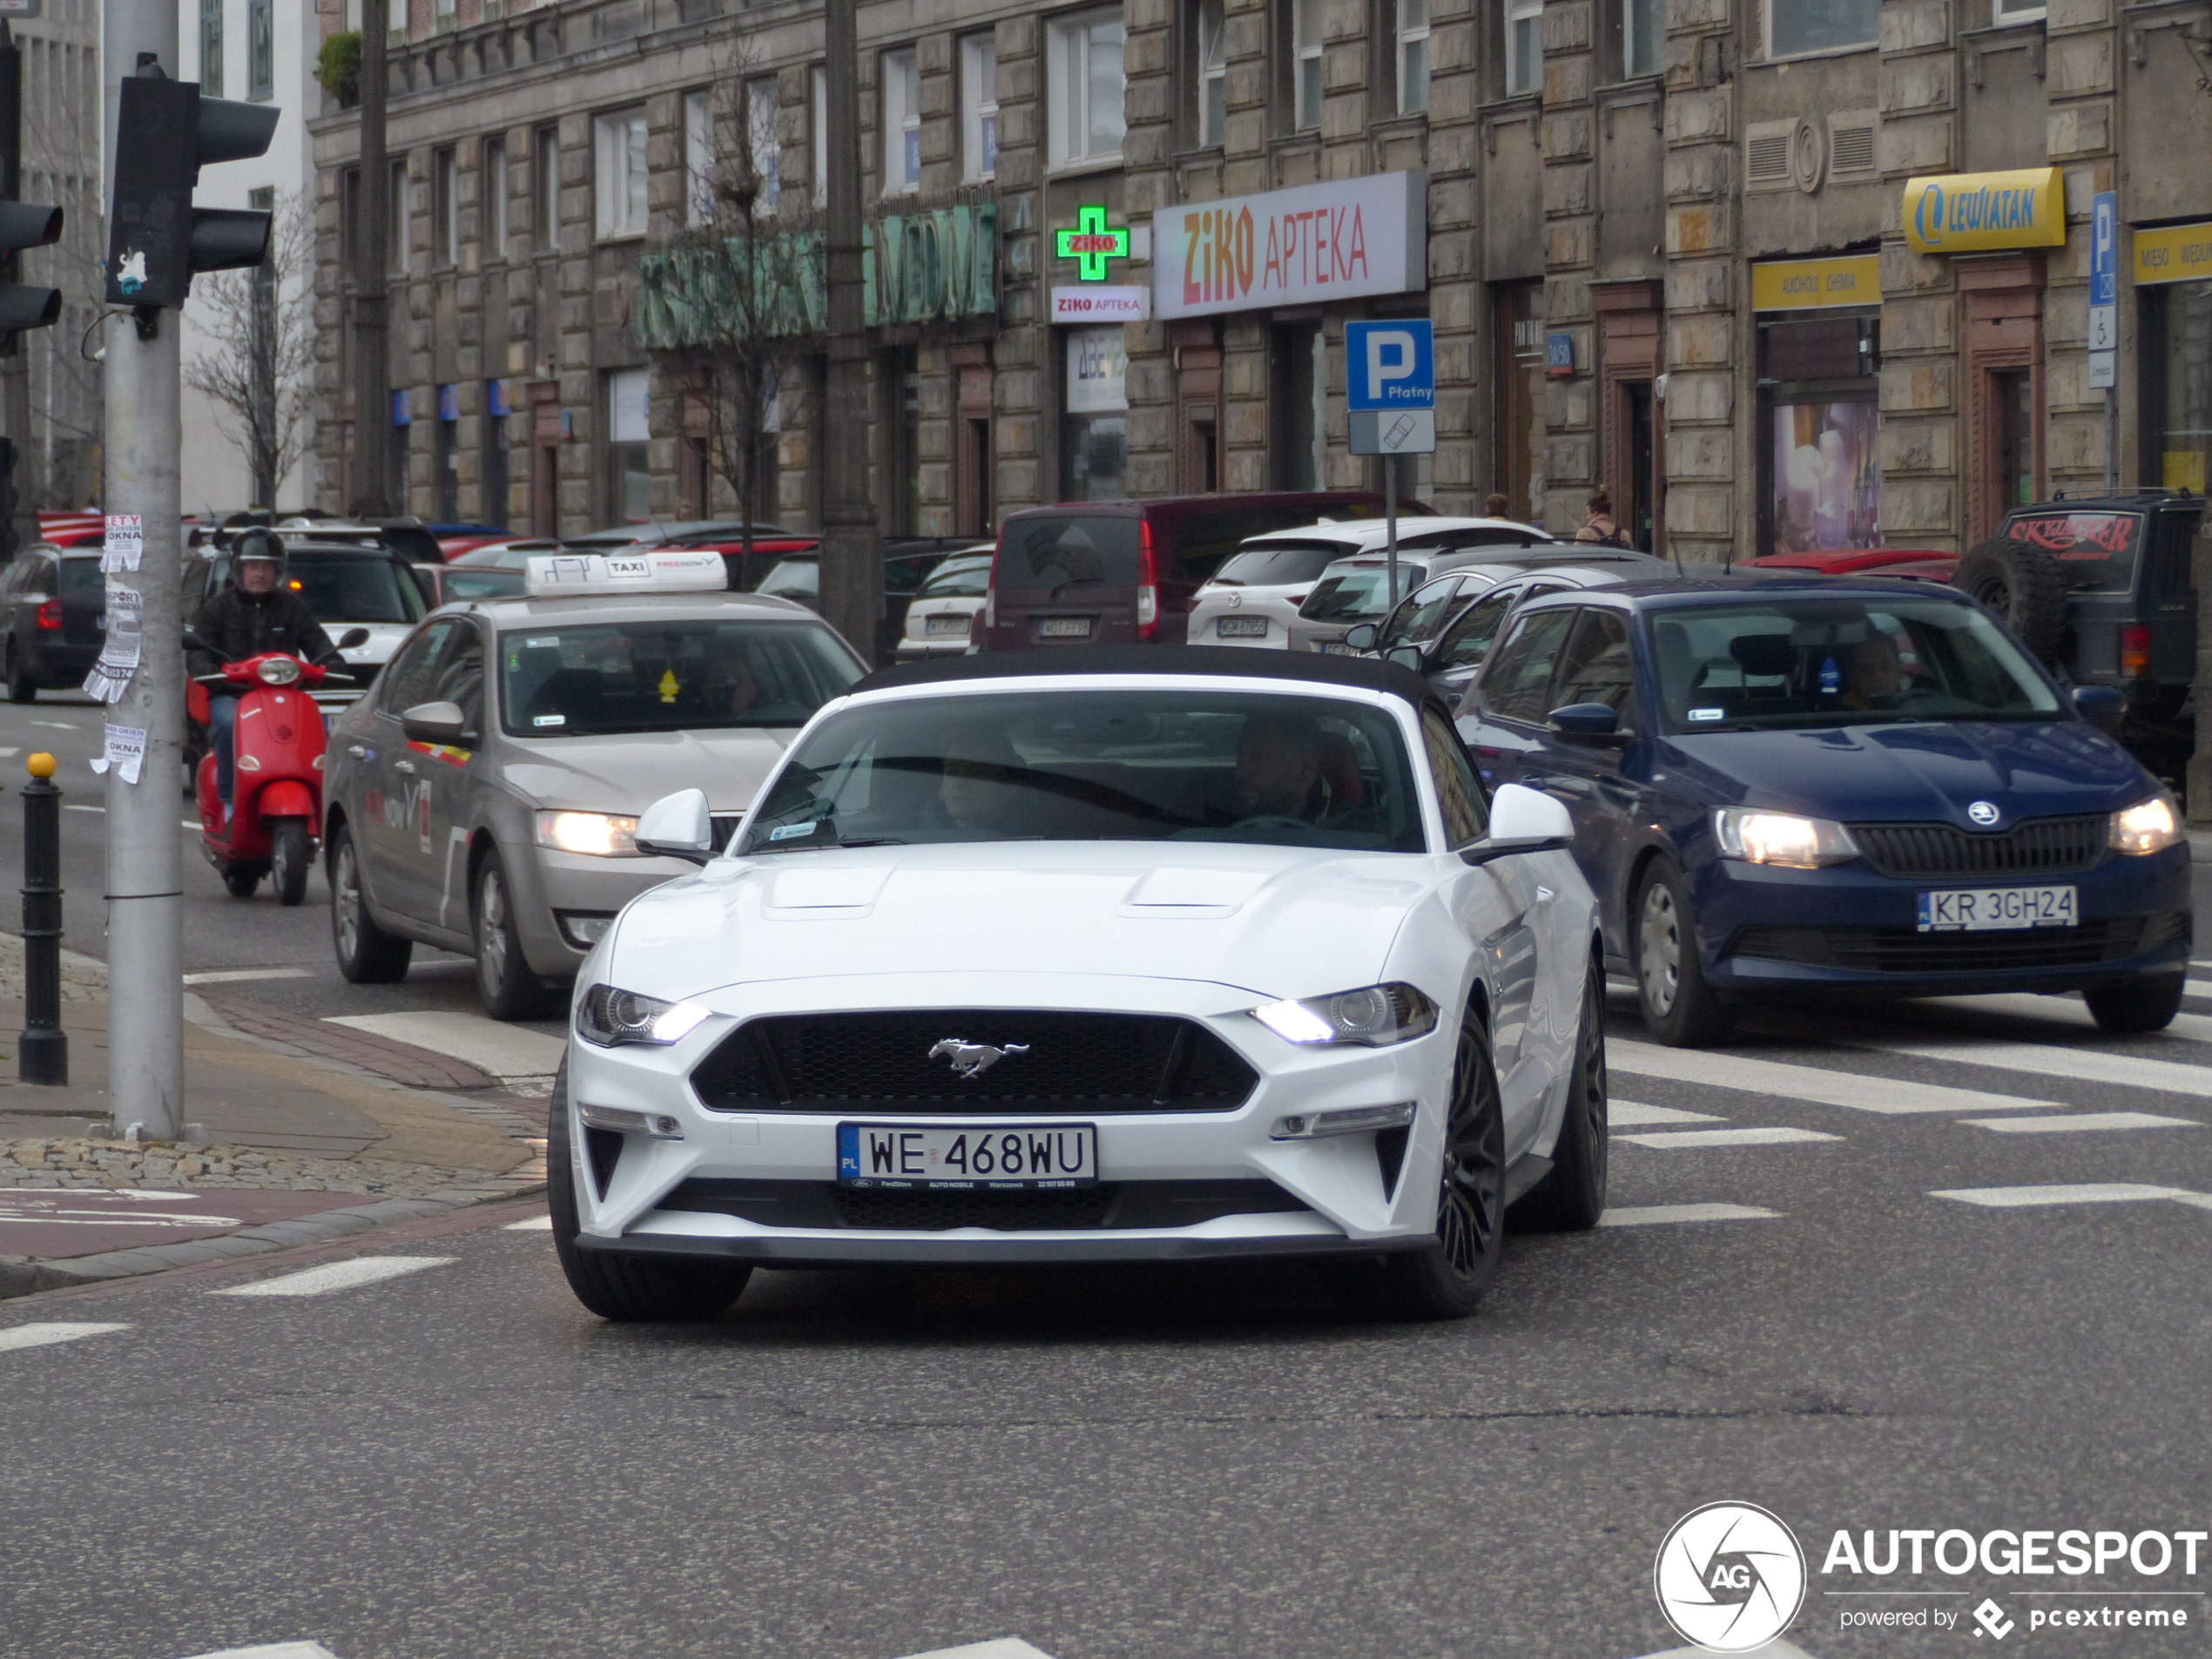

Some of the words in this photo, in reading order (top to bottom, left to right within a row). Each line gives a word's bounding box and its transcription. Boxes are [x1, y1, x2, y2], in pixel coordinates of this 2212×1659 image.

[1949, 185, 2035, 233] LEWIATAN
[1264, 204, 1368, 290] APTEKA
[2096, 203, 2111, 272] P
[1782, 275, 1817, 293] ALKOHOLE
[1827, 273, 1856, 291] CHEMIA
[1095, 300, 1140, 310] APTEKA
[1366, 331, 1416, 400] P
[1388, 386, 1433, 401] Płatny
[2009, 517, 2133, 552] SKYJACKER
[610, 563, 644, 572] TAXI
[110, 742, 140, 753] OKNA
[1936, 894, 1976, 921] KR
[1988, 889, 2072, 919] 3GH24
[842, 1159, 858, 1170] PL
[870, 1133, 924, 1174] WE
[945, 1133, 1082, 1174] 468WU
